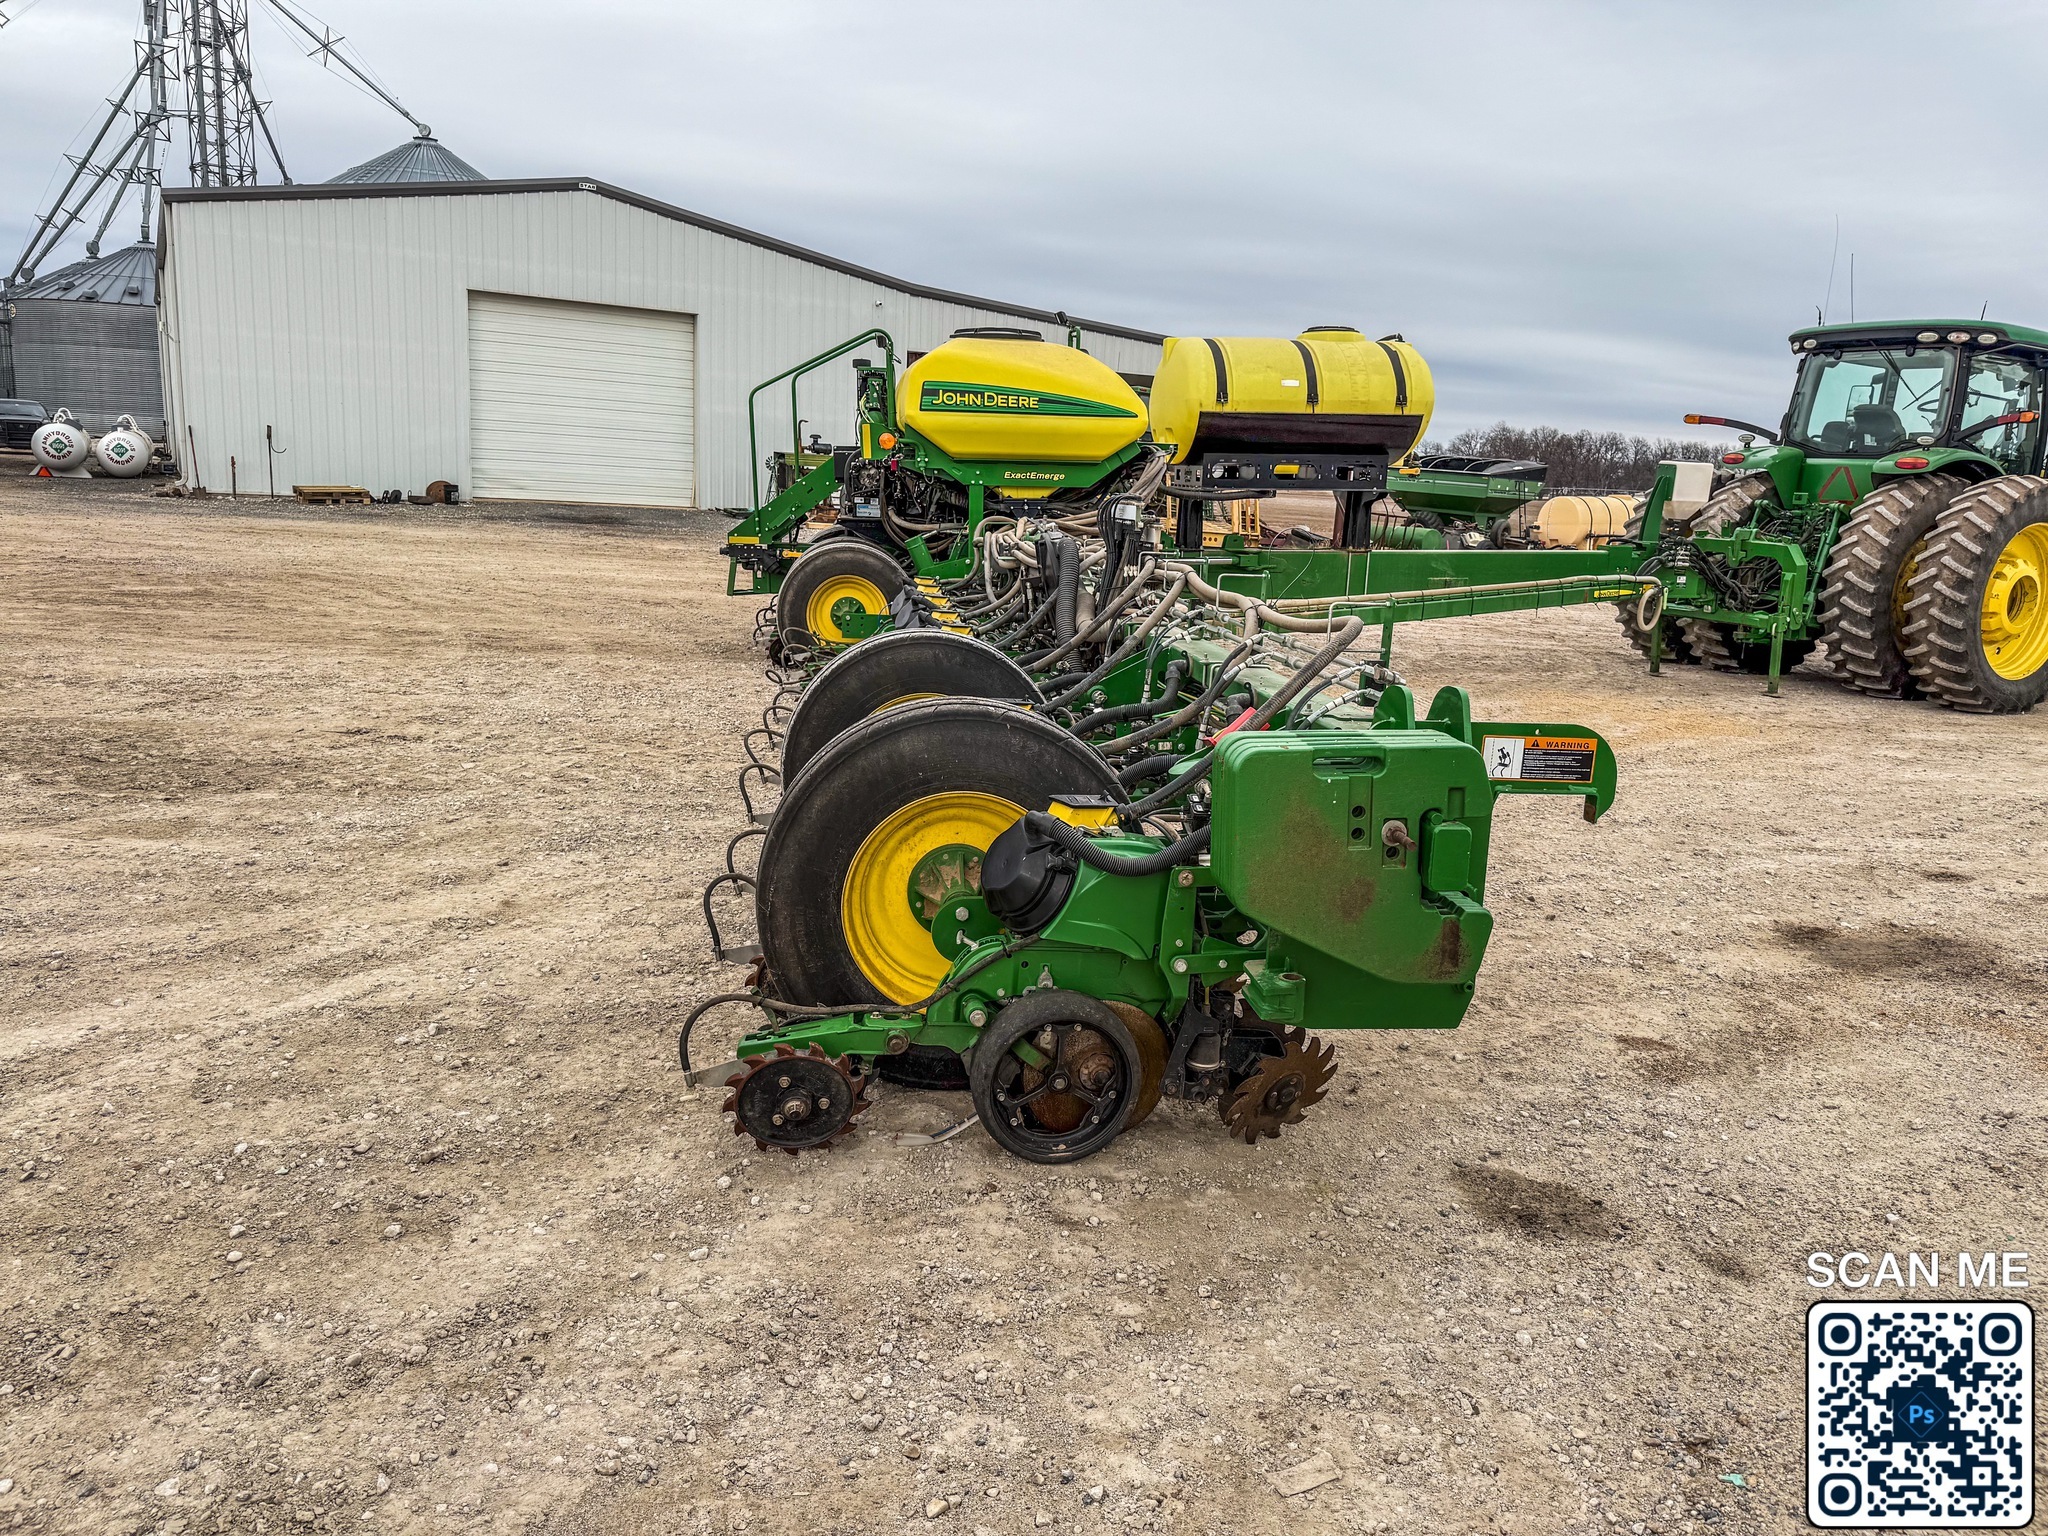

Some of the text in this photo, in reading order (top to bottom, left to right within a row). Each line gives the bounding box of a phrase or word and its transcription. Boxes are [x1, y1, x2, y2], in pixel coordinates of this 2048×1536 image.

[932, 389, 1039, 409] JOHN DEERE
[42, 431, 74, 448] ANHYDROUS
[105, 437, 136, 452] ANHYDROUS
[42, 446, 72, 460] AMMONIA
[106, 453, 135, 466] AMMONIA
[1004, 471, 1065, 481] ExactEmerge
[1546, 741, 1590, 749] WARNING
